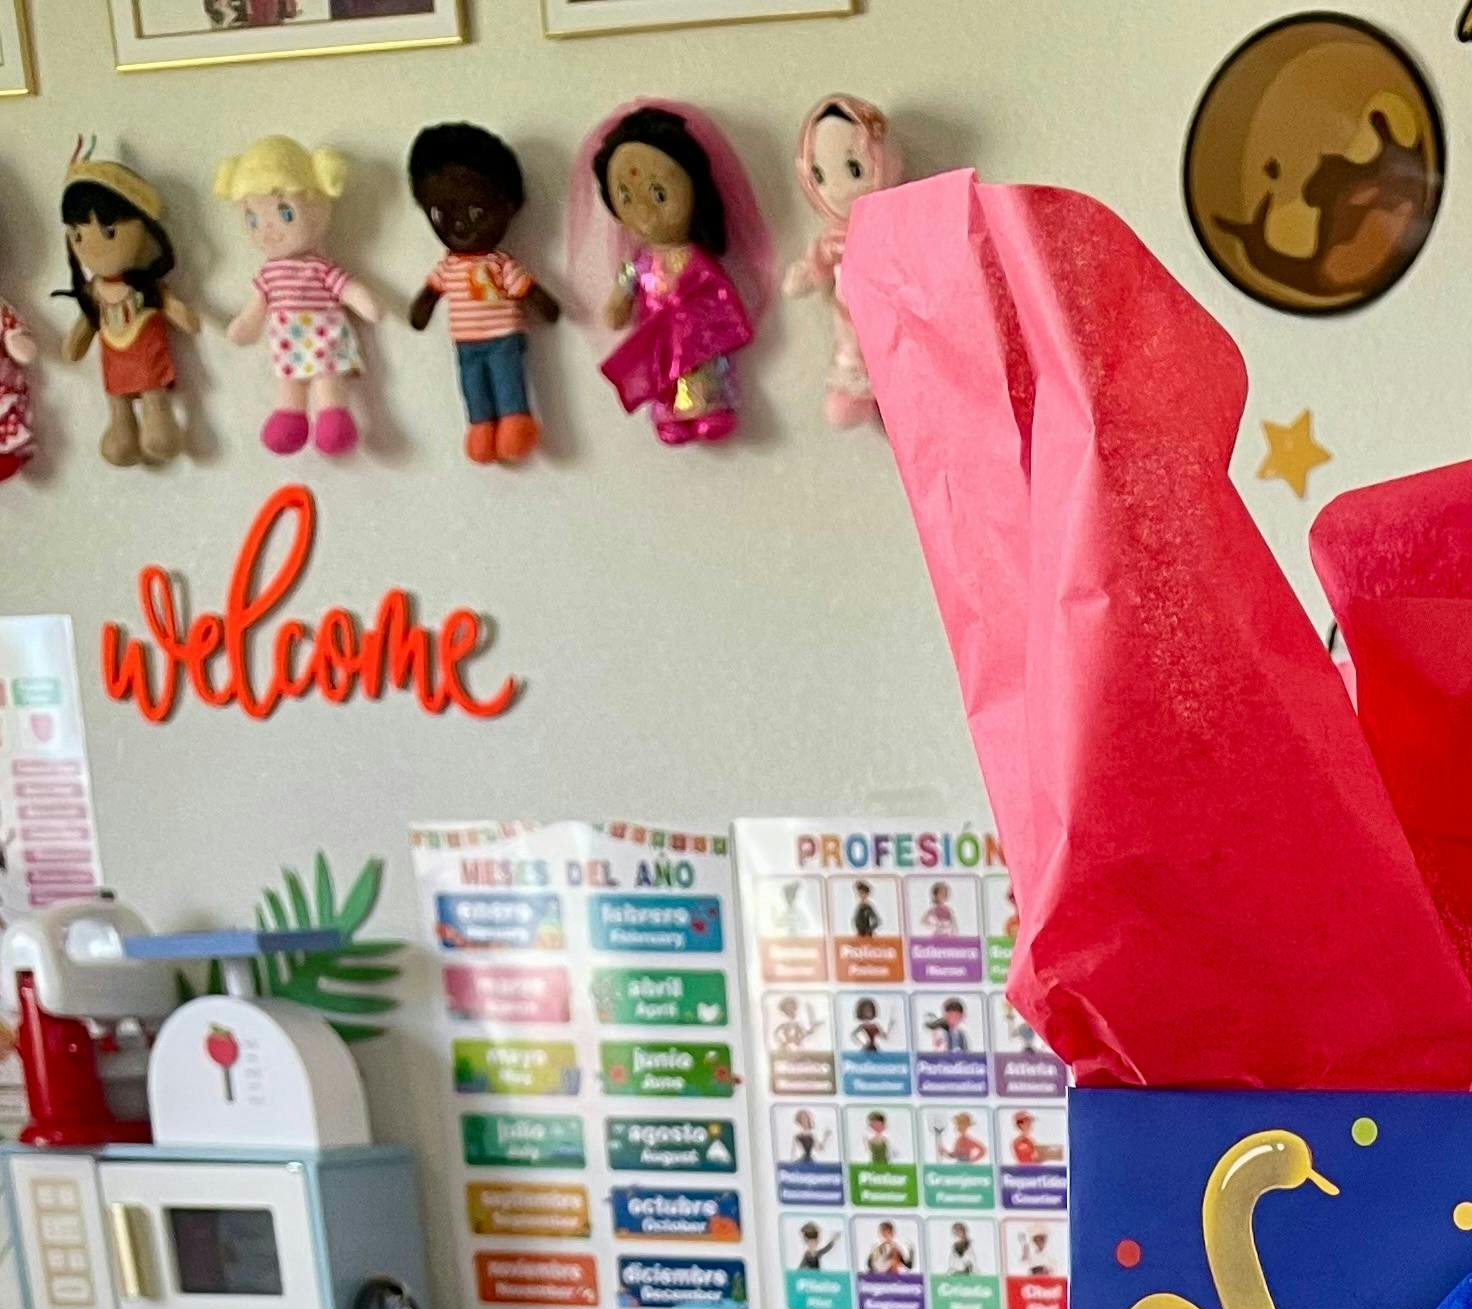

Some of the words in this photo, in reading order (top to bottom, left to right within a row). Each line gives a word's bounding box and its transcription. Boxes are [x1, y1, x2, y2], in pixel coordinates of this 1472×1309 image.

[102, 483, 517, 722] welcome
[460, 859, 549, 886] MESES
[565, 860, 620, 887] DEL
